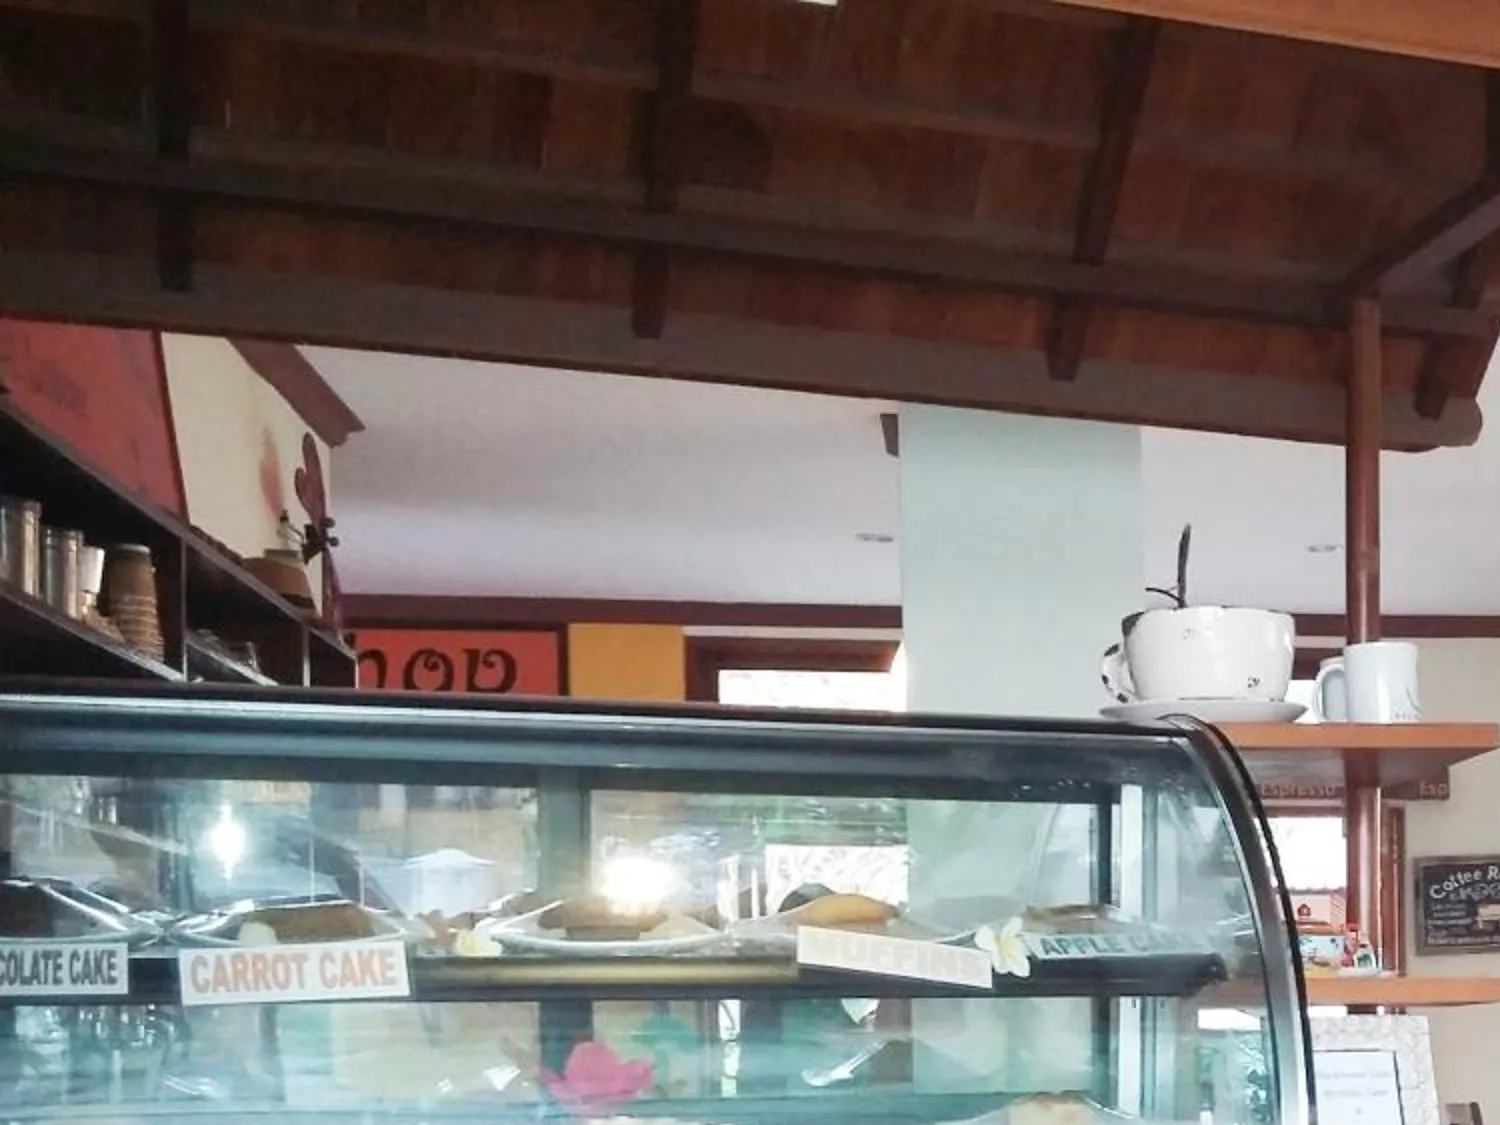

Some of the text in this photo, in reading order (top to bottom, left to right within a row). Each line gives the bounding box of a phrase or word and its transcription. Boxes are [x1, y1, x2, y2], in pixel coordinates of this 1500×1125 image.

[1429, 867, 1482, 899] Coffee
[1039, 935, 1126, 955] APPLE
[69, 948, 118, 986] CAKE
[190, 948, 399, 995] CARROT CAKE
